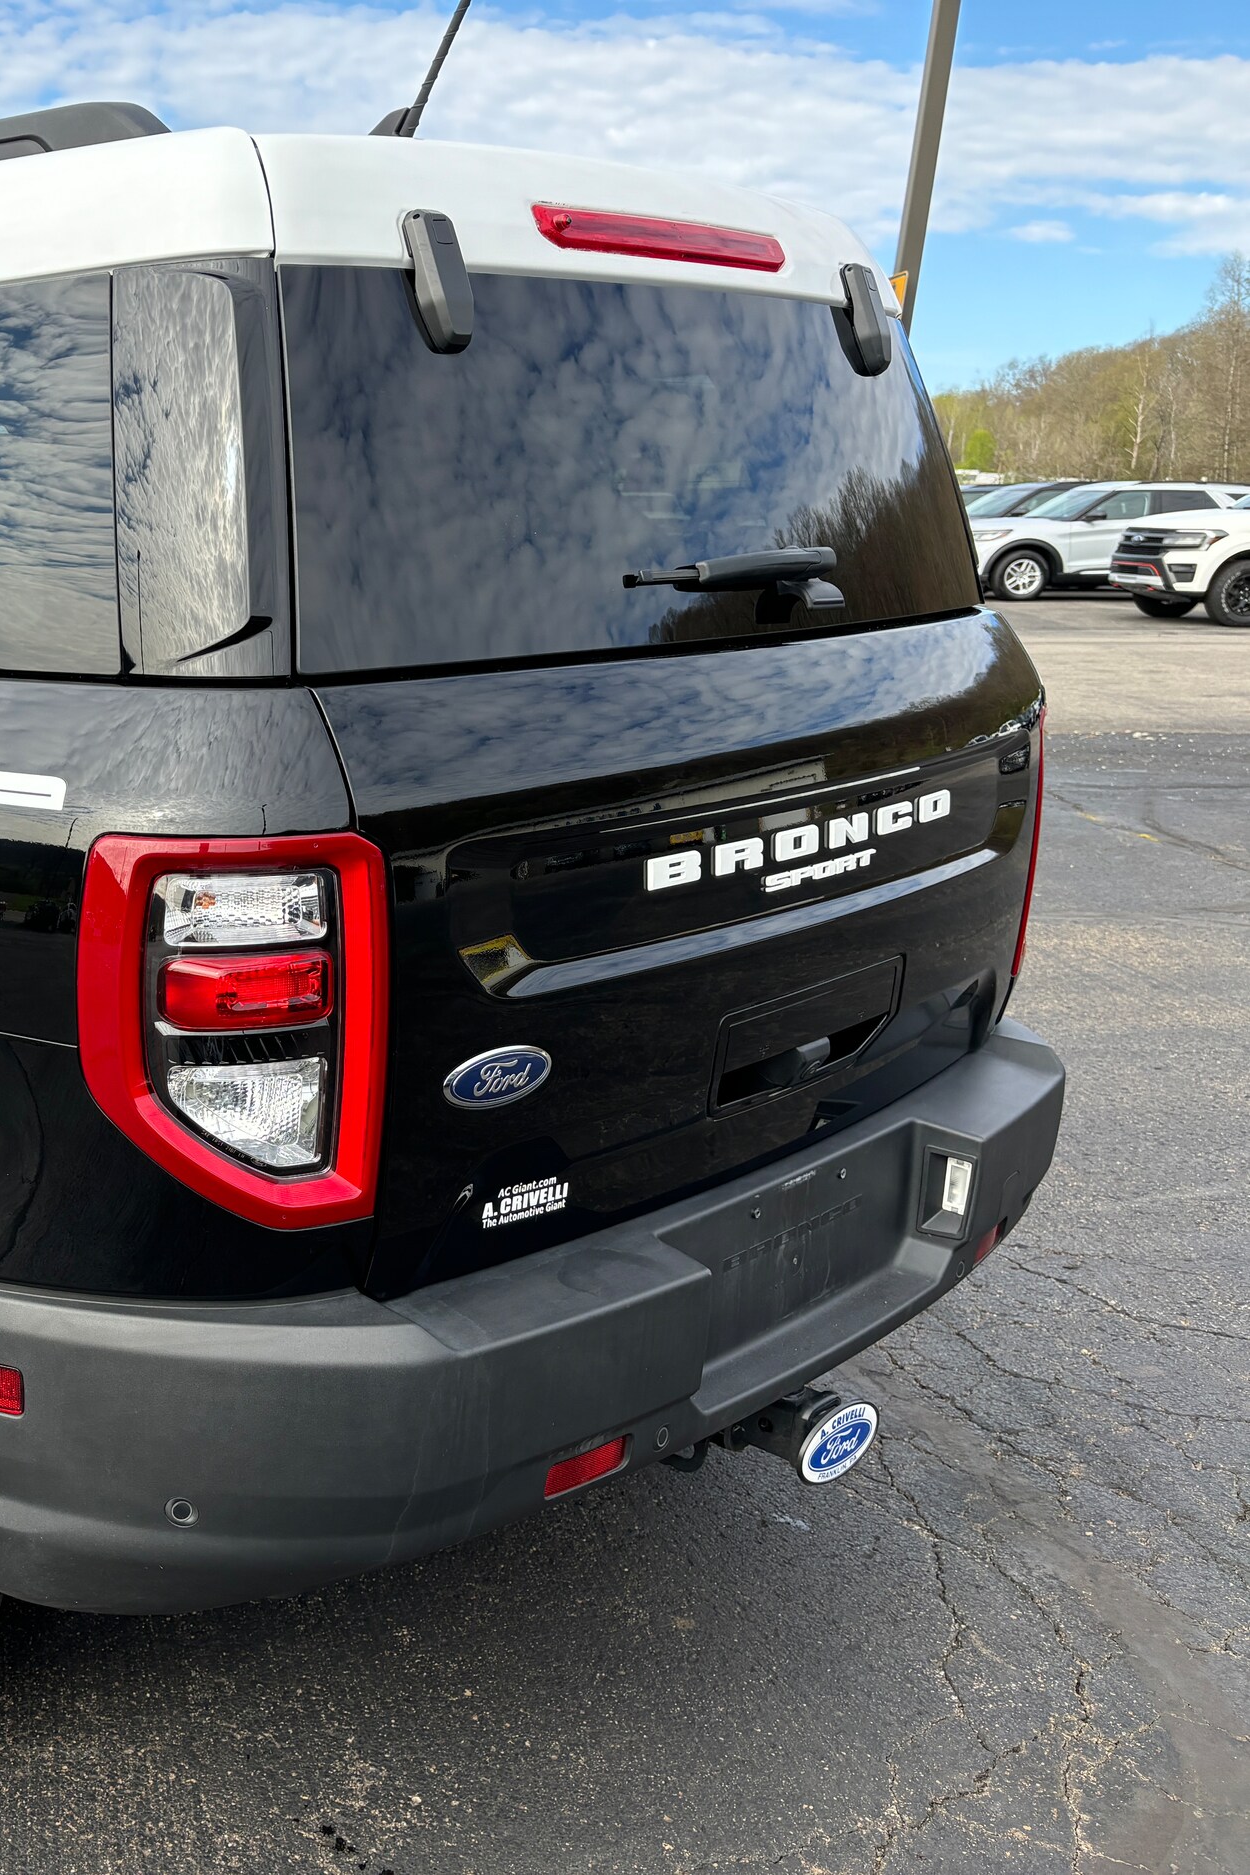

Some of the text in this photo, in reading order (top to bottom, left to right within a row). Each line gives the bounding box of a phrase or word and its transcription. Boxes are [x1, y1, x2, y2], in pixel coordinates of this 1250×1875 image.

[643, 788, 951, 892] BRONCO
[760, 848, 877, 893] SPORT
[473, 1059, 532, 1097] Ford
[482, 1182, 569, 1218] A. CRIVELLI
[497, 1176, 557, 1198] AC Giant.com
[482, 1199, 567, 1229] The Automotive Giant
[722, 1193, 863, 1273] BRONCO
[820, 1407, 866, 1440] A. CRIVELLI
[821, 1427, 861, 1465] Ford
